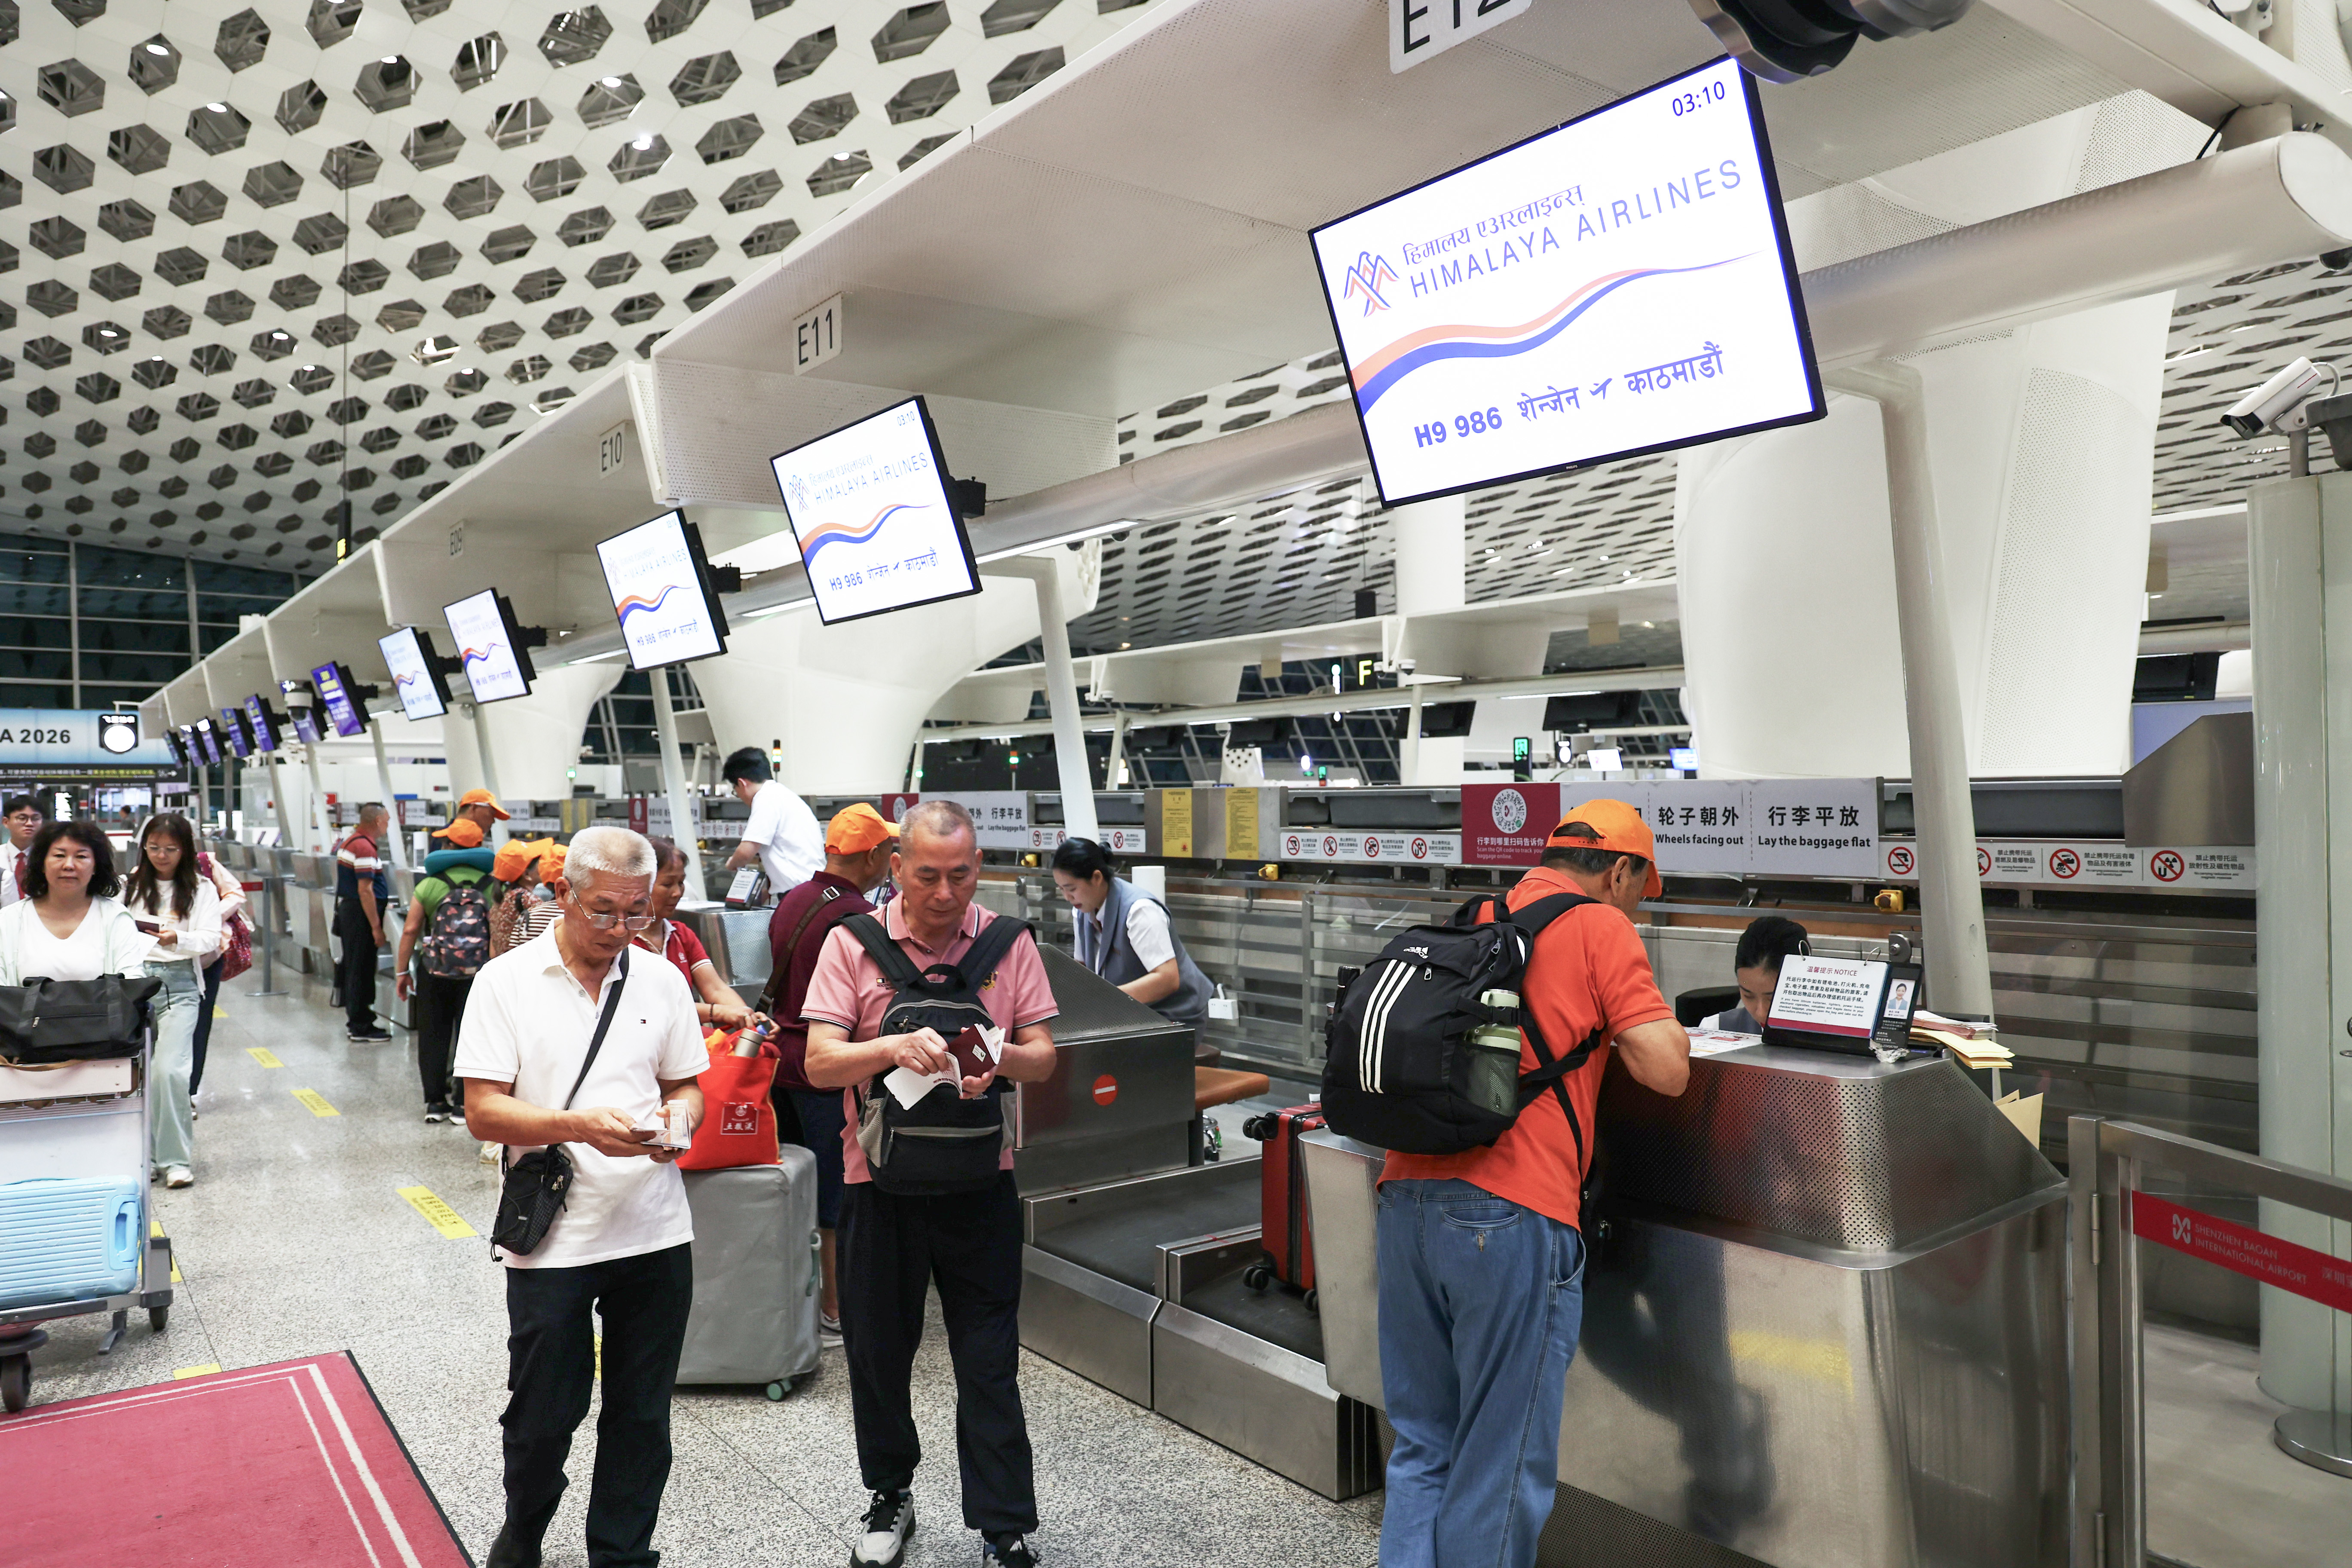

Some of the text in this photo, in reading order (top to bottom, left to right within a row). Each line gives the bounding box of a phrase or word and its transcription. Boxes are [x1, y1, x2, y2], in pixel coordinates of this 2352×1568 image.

[1672, 80, 1726, 117] 03:10
[1410, 159, 1741, 298] HIMALAYA AIRLINES
[1402, 227, 1471, 265] हिमालय
[798, 309, 833, 366] E11
[1517, 341, 1725, 422] शेन्जेन काठमाडौं
[897, 410, 916, 426] 03:10
[1415, 407, 1503, 448] H9 986
[601, 432, 623, 472] E10
[814, 452, 928, 505] HIMALAYA AIRLINES
[829, 572, 863, 591] H9 986
[1359, 660, 1373, 686] F
[20, 729, 70, 744] 2026
[991, 807, 1022, 820] 行李平放
[1658, 805, 1740, 827] 轮子朝外
[1768, 805, 1860, 827] 行李平放
[1477, 837, 1544, 846] 行李到哪里扫码告诉你
[1655, 833, 1744, 847] Wheels facing out
[1758, 835, 1871, 849] Lay the baggage flat
[1403, 948, 1428, 959] adidas
[1807, 966, 1833, 974] 温馨提示
[2195, 1223, 2278, 1260] SHENZHEN BAOAN
[2195, 1237, 2307, 1285] INTERNATIONAL AIRPORT
